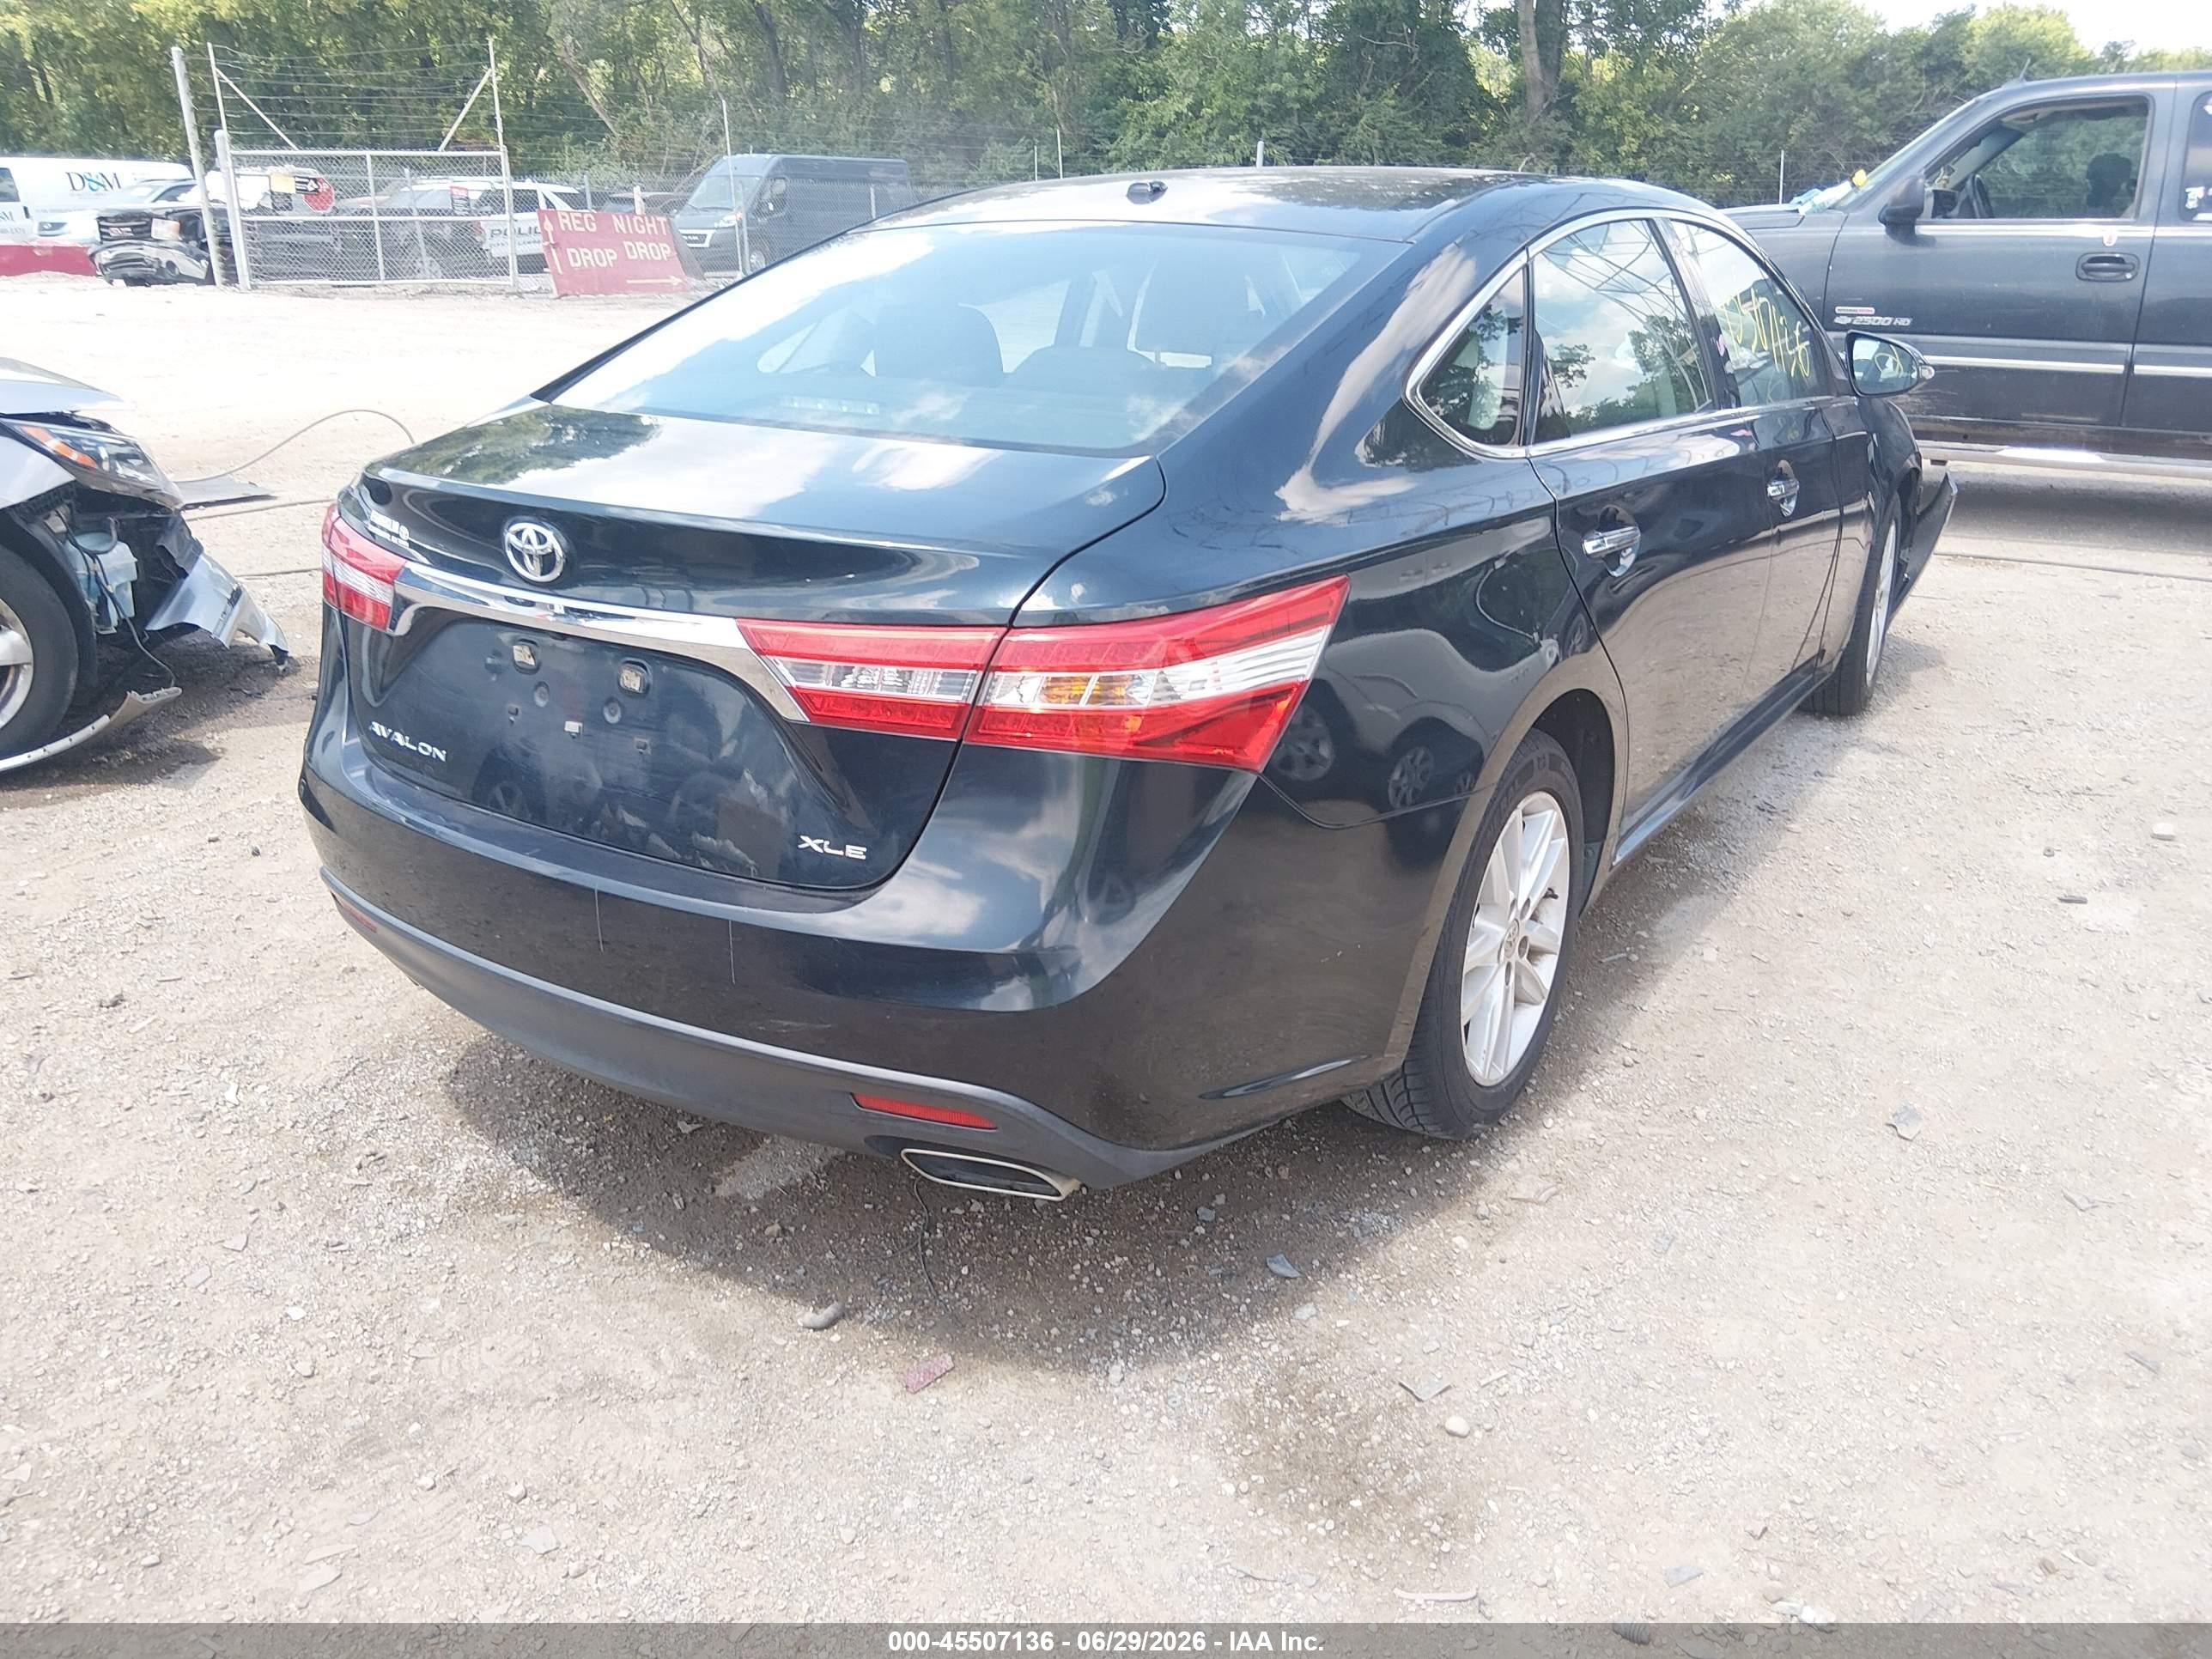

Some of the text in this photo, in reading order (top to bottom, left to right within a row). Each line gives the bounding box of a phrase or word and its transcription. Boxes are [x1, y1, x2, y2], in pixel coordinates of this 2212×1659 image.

[557, 212, 668, 236] REG NIGHT
[567, 240, 672, 268] DROP DROP
[1852, 316, 1893, 326] 2500
[368, 720, 447, 762] AVALON
[798, 835, 867, 860] XLE
